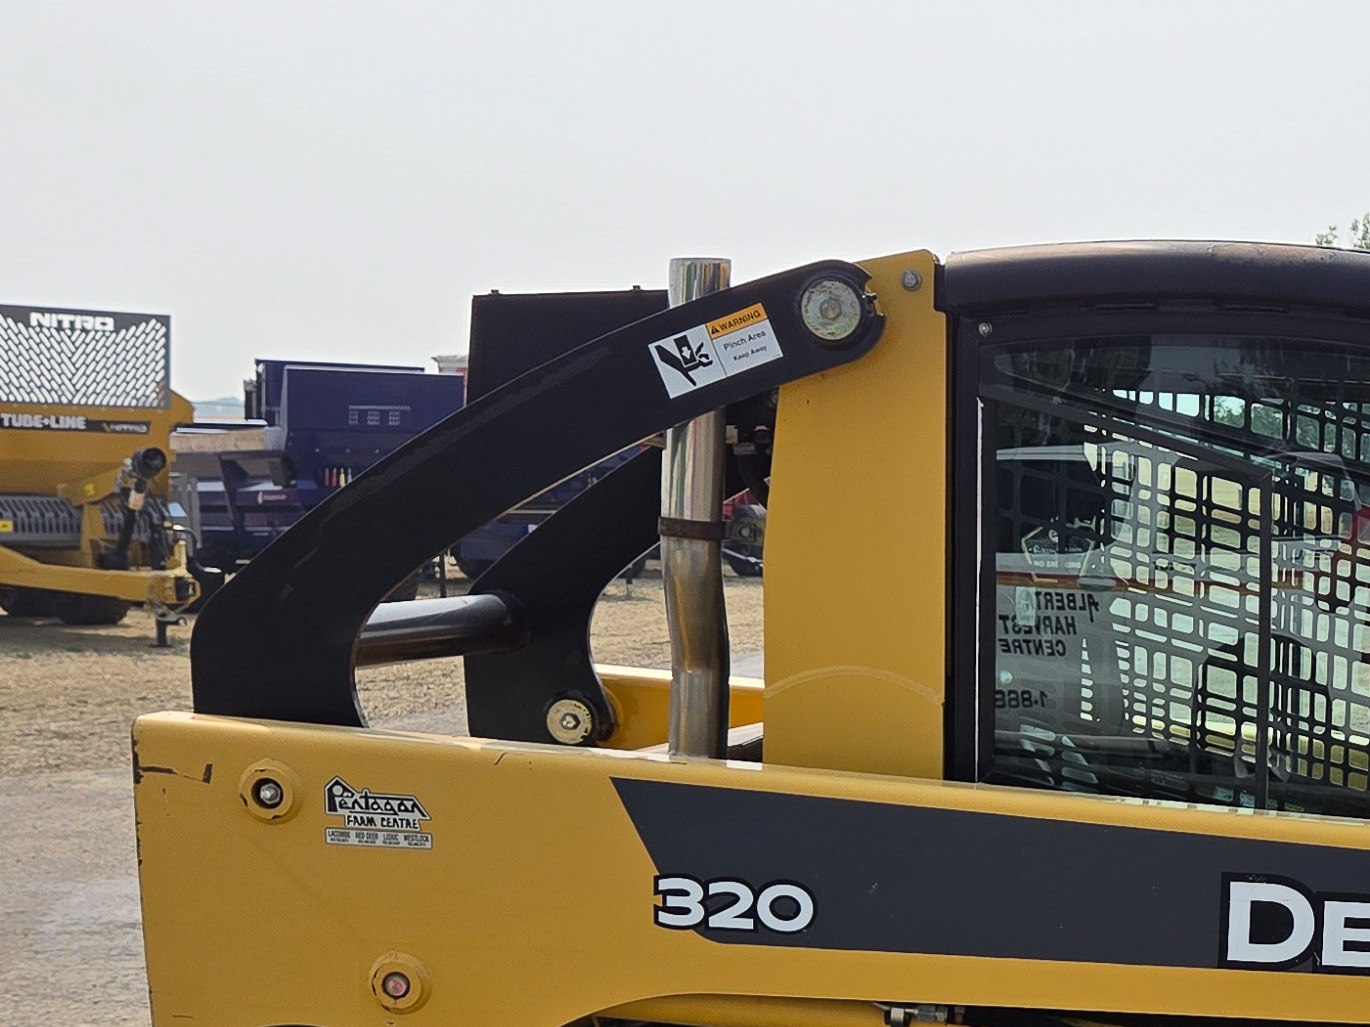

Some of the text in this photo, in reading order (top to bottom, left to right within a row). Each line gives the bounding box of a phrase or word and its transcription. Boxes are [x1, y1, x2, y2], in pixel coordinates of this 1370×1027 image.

[30, 311, 114, 331] NITRO
[719, 310, 761, 331] WARNING
[723, 330, 767, 351] Pinch Area
[733, 345, 768, 361] Keep Away
[327, 779, 427, 818] Pentagon
[347, 815, 419, 830] FARM CENTRE
[656, 876, 815, 933] 320
